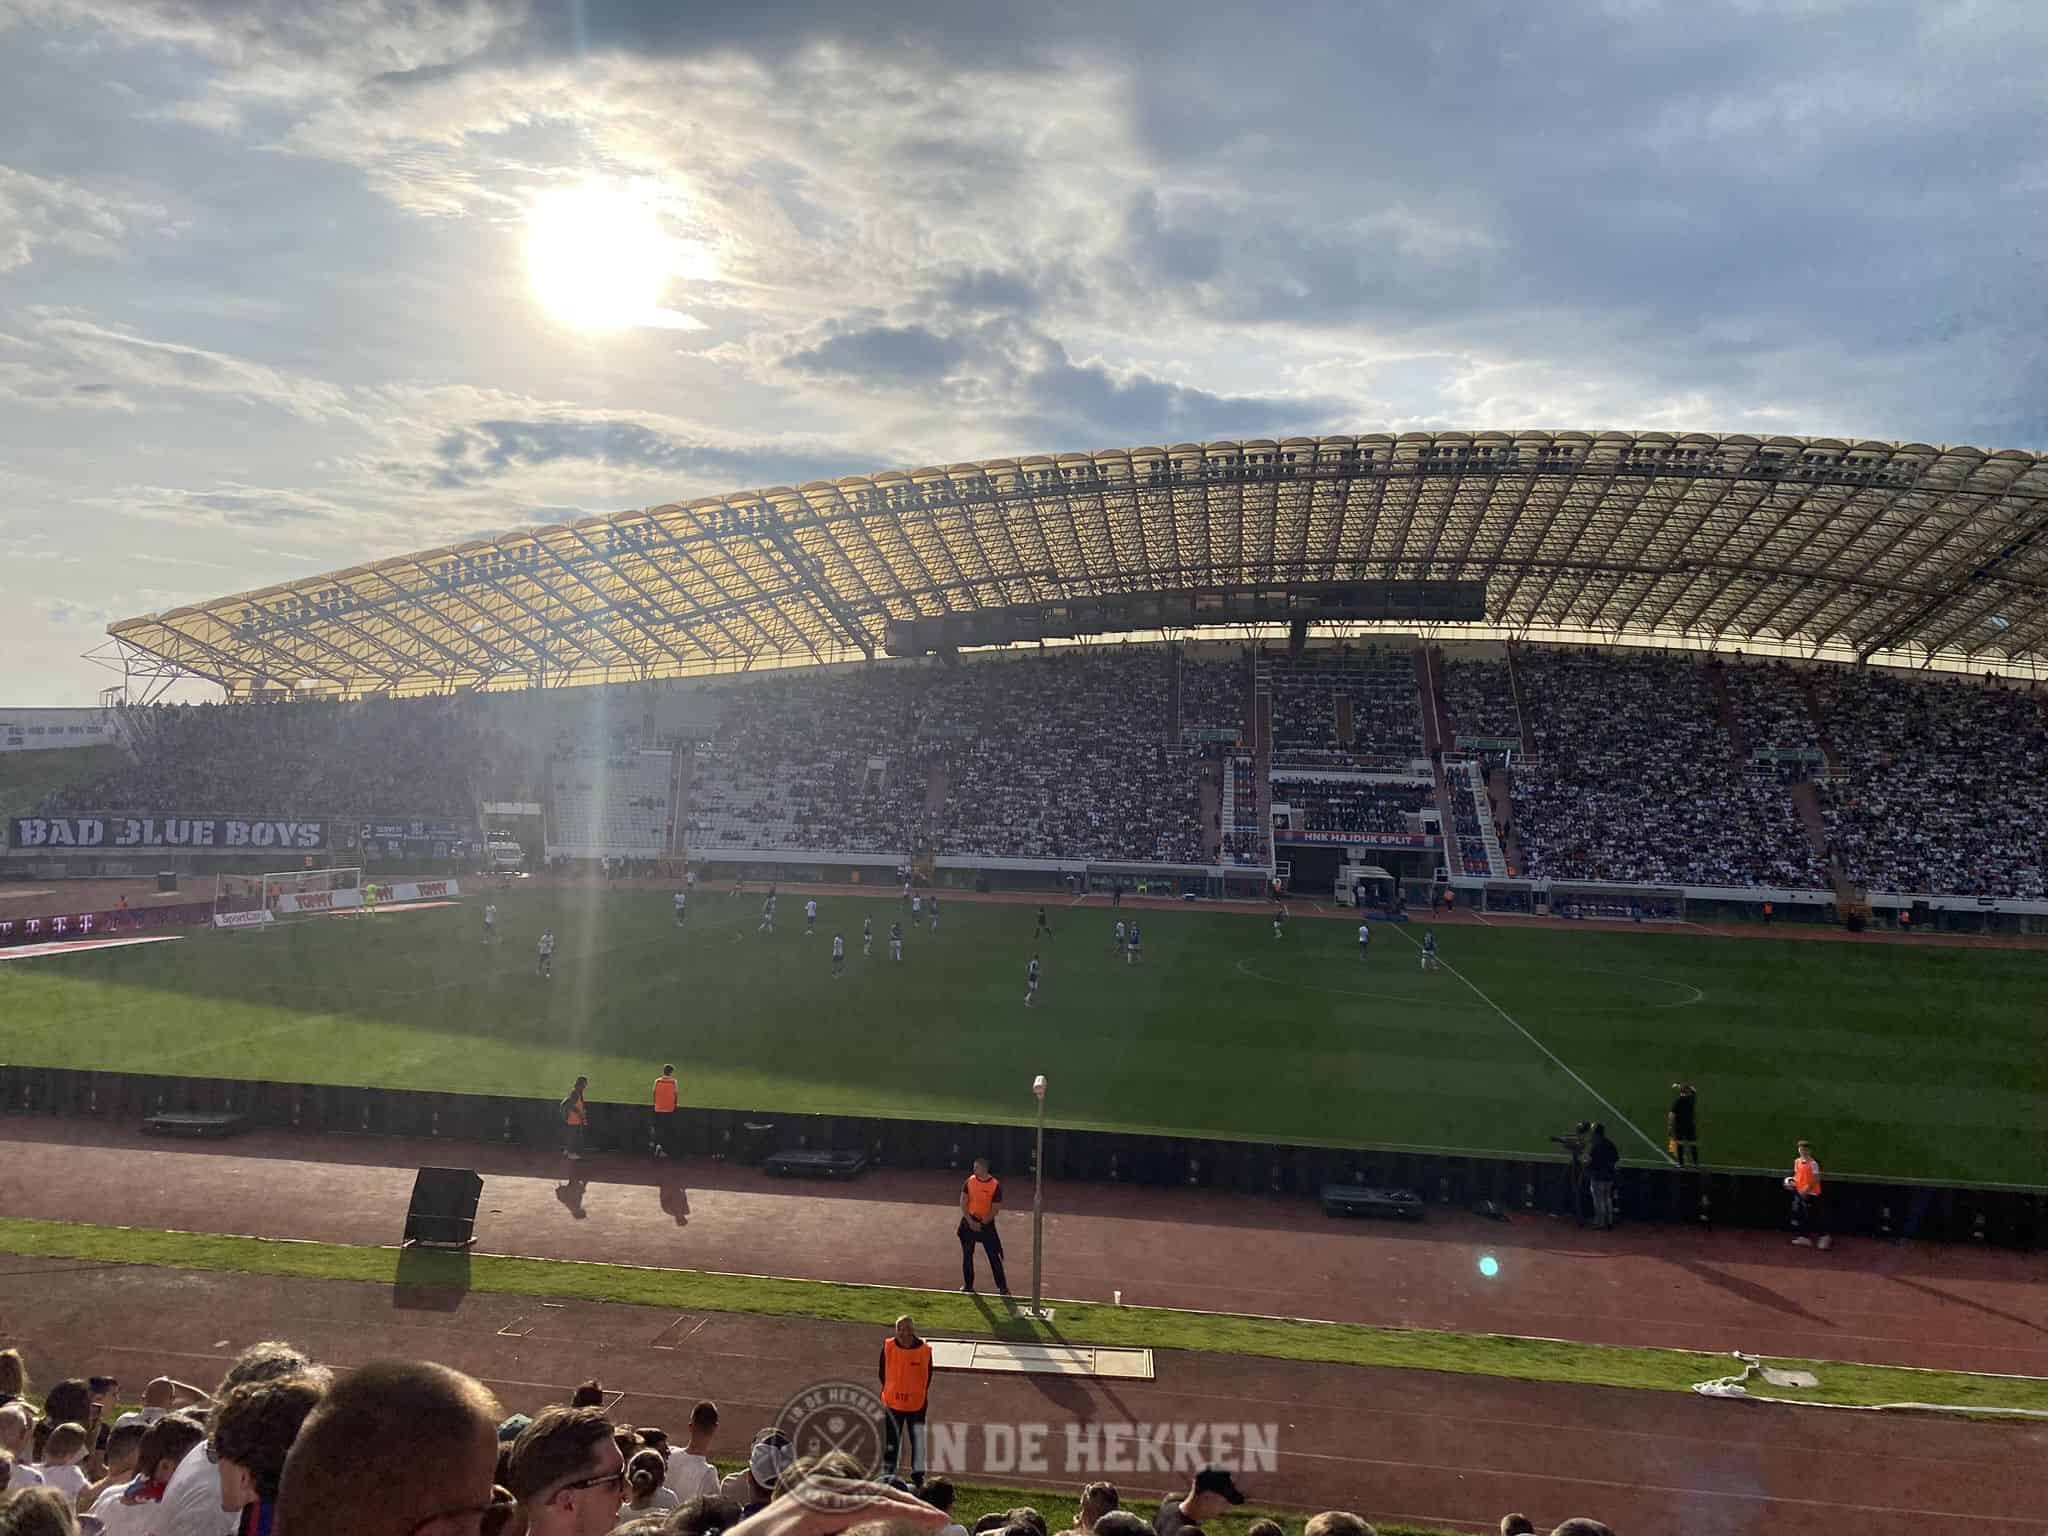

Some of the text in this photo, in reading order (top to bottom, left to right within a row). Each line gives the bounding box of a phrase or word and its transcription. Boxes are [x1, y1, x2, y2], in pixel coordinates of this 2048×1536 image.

[19, 819, 103, 846] BAD
[225, 820, 321, 846] BOYS
[1304, 832, 1412, 845] HNK HAJDUK SPLIT
